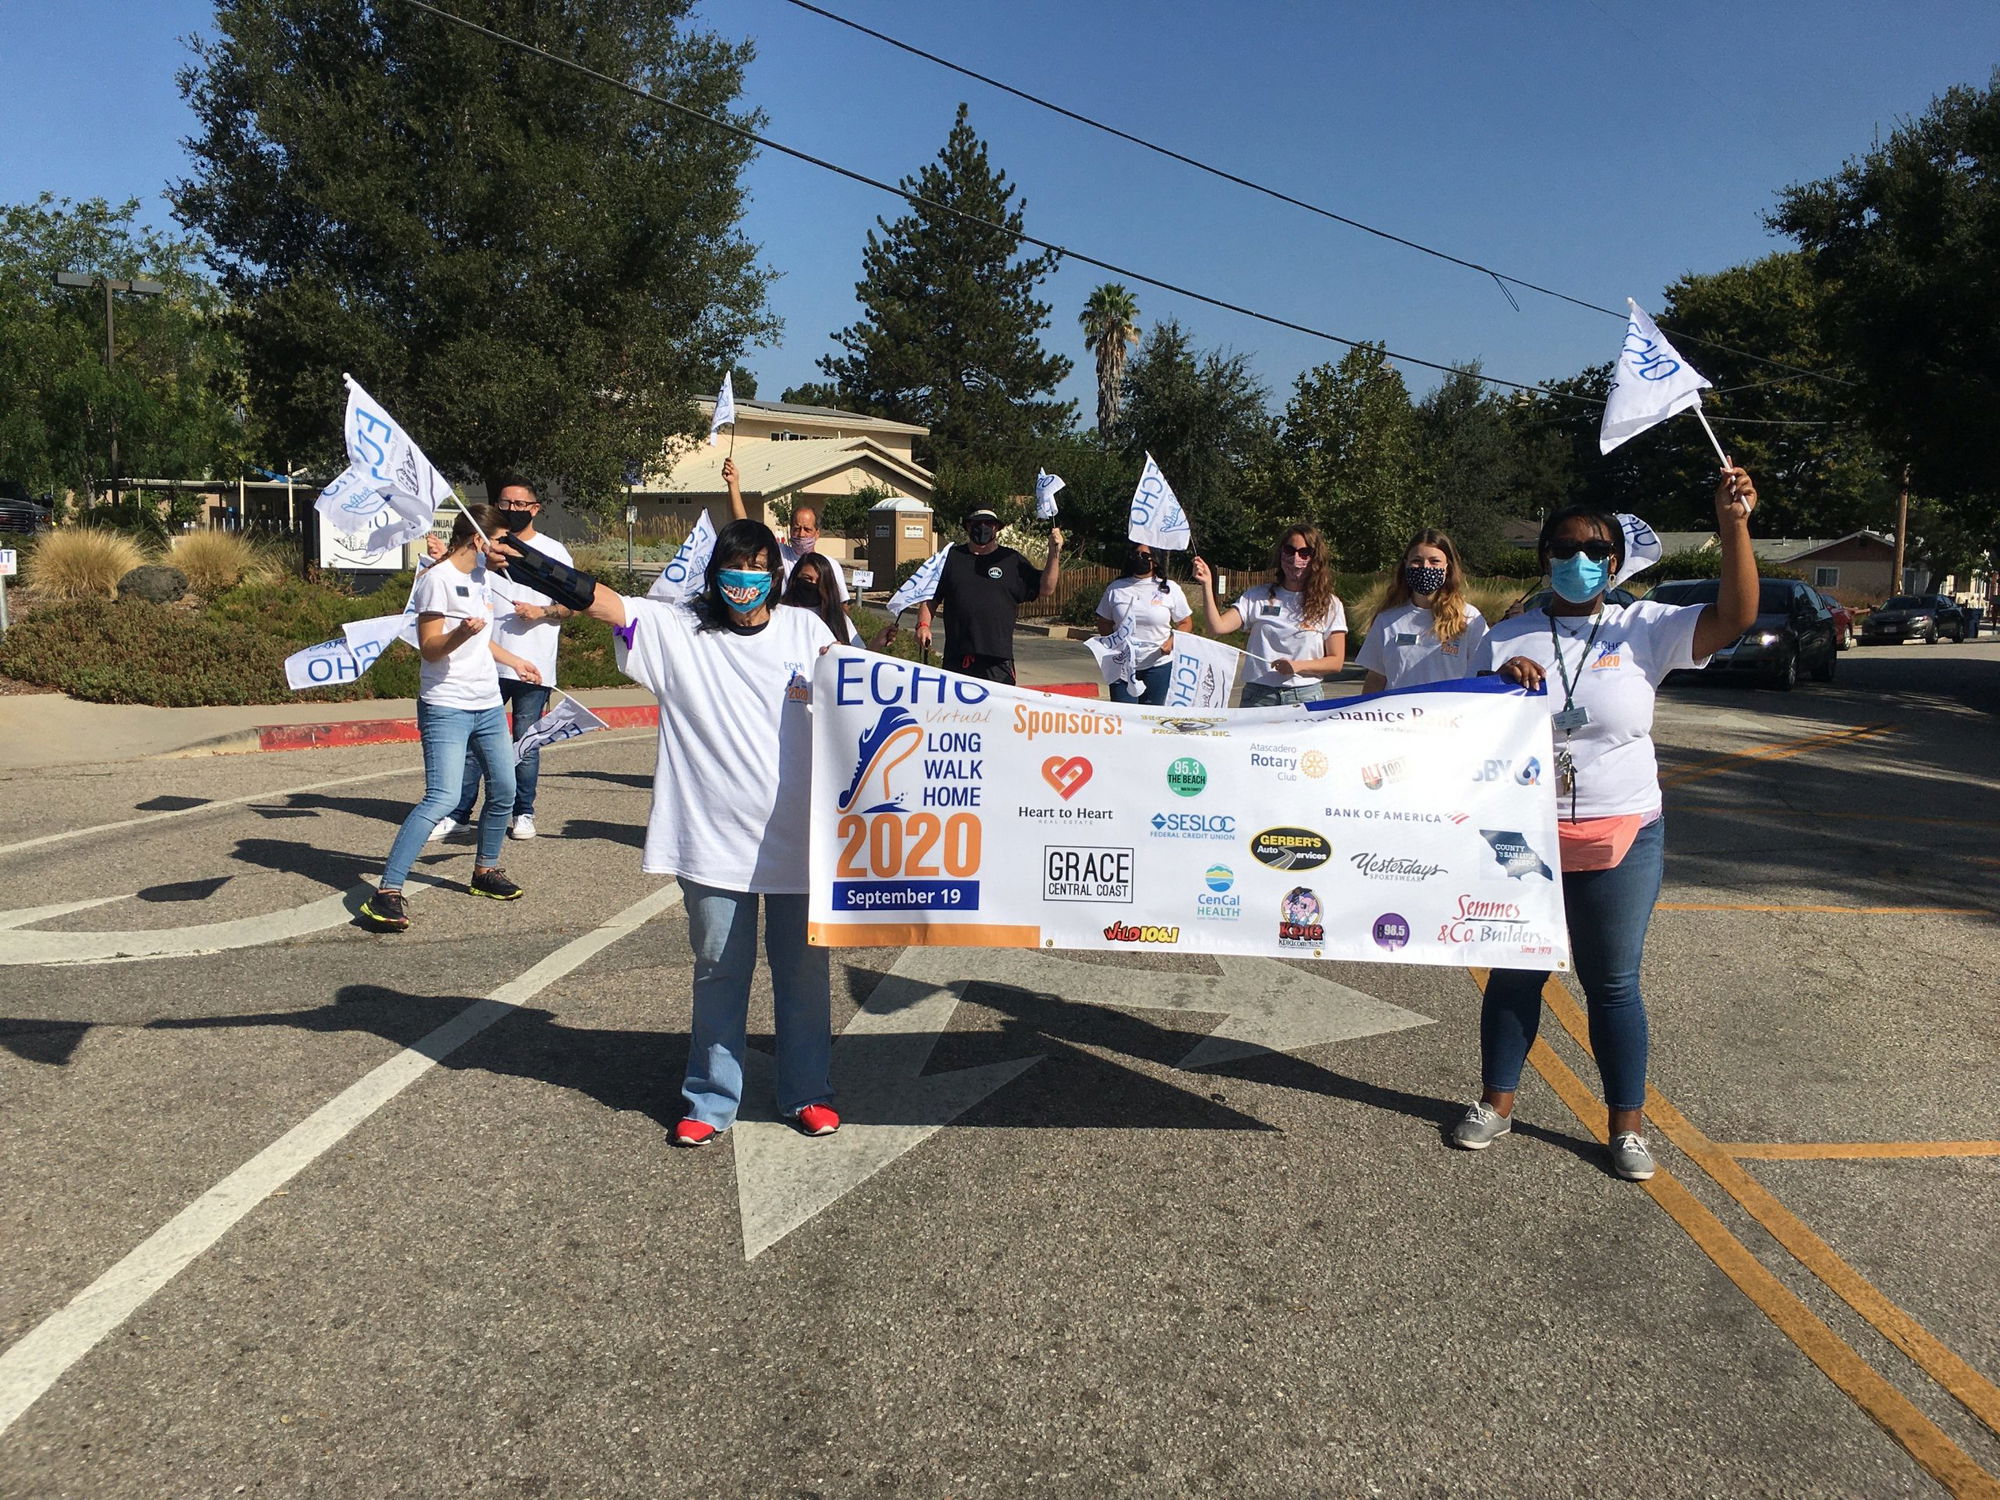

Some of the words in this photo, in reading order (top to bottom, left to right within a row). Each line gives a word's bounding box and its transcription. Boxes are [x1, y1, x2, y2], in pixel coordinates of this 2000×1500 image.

[925, 708, 992, 724] Virtual
[1013, 703, 1123, 741] Sponsors!
[928, 732, 981, 753] LONG
[1250, 743, 1297, 753] Atascadero
[924, 759, 983, 780] WALK
[1174, 761, 1200, 775] 95.3
[1251, 754, 1297, 770] Rotary
[1168, 774, 1182, 784] THE
[1182, 775, 1206, 785] BEACH
[1277, 774, 1297, 782] Club
[923, 786, 981, 807] HOME
[1018, 806, 1054, 818] Heart
[1059, 808, 1072, 818] to
[1077, 808, 1113, 820] Heart
[1325, 807, 1360, 818] BANK
[1364, 810, 1380, 819] OF
[1383, 811, 1442, 823] AMERICA
[1167, 814, 1236, 833] SESLOC
[836, 812, 982, 878] 2020
[1260, 834, 1322, 848] GERBER'S
[1495, 843, 1525, 852] COUNTY
[1257, 845, 1279, 854] Auto
[1049, 851, 1130, 884] GRACE
[1350, 852, 1448, 881] Yesterdays
[1048, 883, 1092, 896] CENTRAL
[1096, 885, 1129, 897] COAST
[847, 888, 935, 909] September
[941, 888, 961, 904] 19
[1198, 893, 1240, 906] CenCal
[1197, 906, 1240, 917] HEALTH
[1452, 894, 1520, 920] Semmes
[1279, 922, 1324, 940] KPIG
